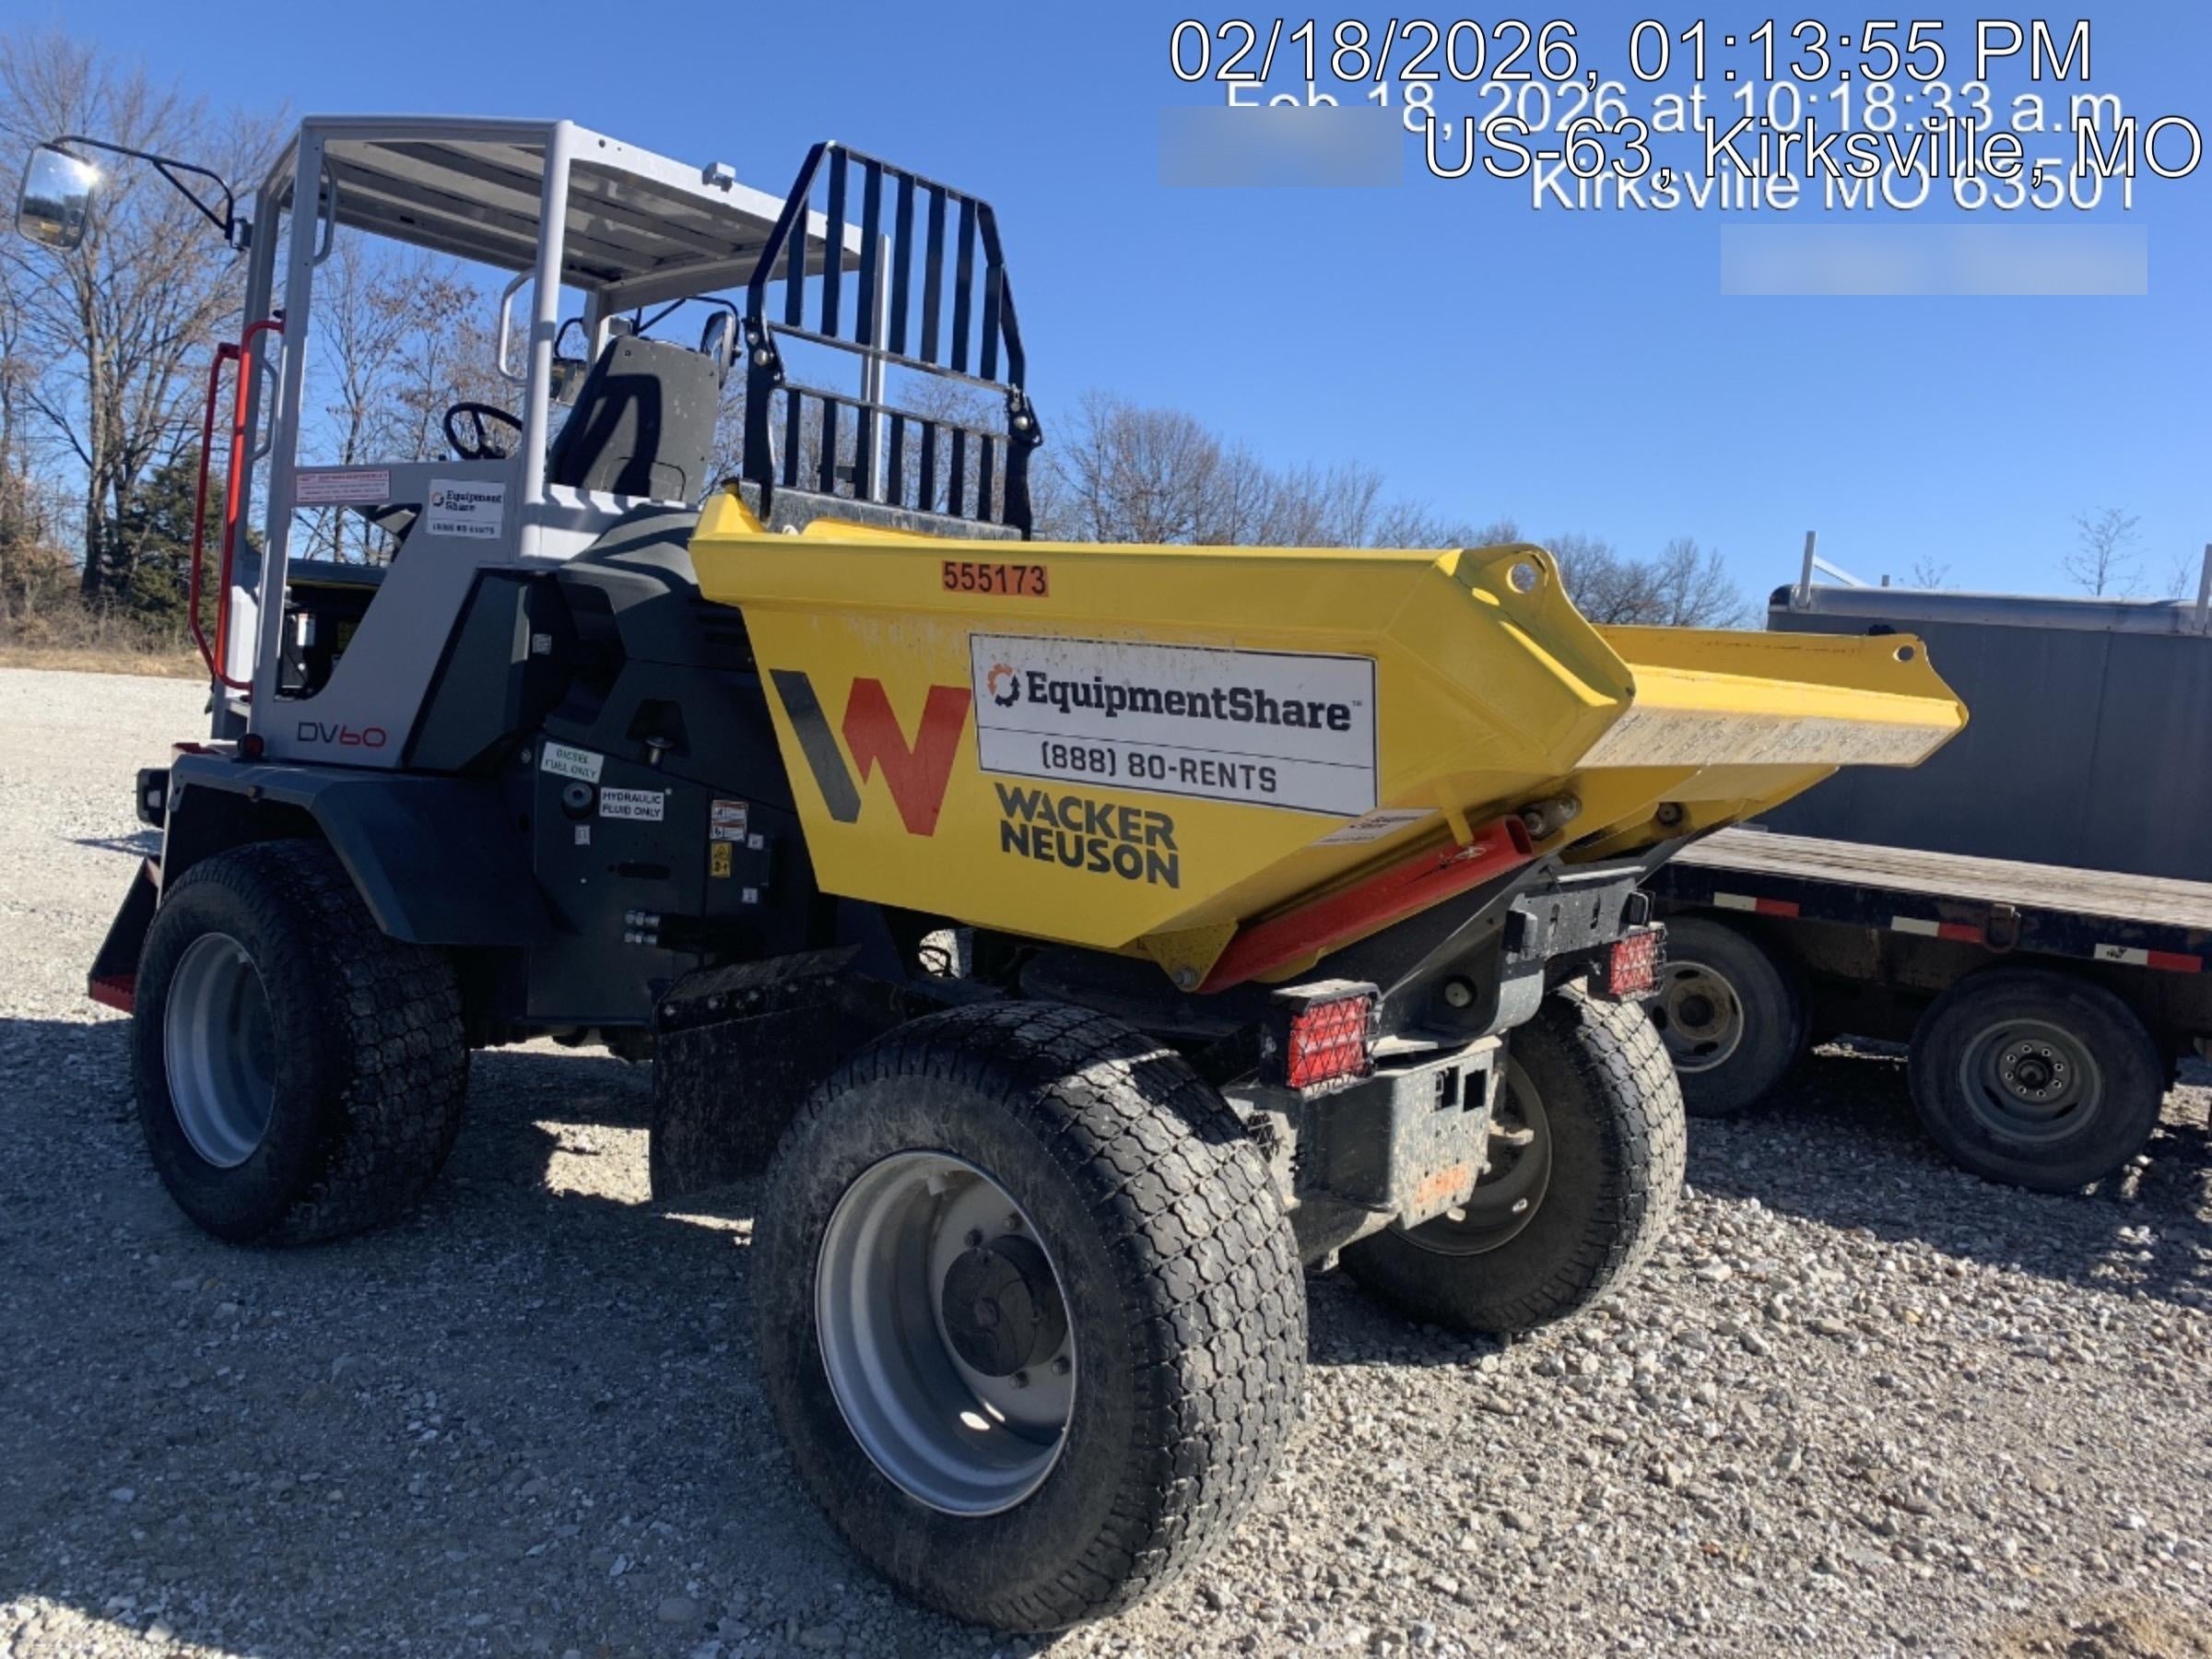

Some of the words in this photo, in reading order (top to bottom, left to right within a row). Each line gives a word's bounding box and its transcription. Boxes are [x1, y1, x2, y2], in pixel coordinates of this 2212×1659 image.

[943, 560, 1047, 597] 555173
[297, 722, 386, 747] DV60
[1041, 741, 1117, 777] (888)
[1128, 753, 1277, 794] 80-RENTS
[602, 790, 662, 804] HYDRAULIC
[602, 803, 631, 816] FLUID
[633, 806, 662, 818] ONLY
[994, 782, 1179, 851] WACKER
[1000, 820, 1180, 889] NEUSON
